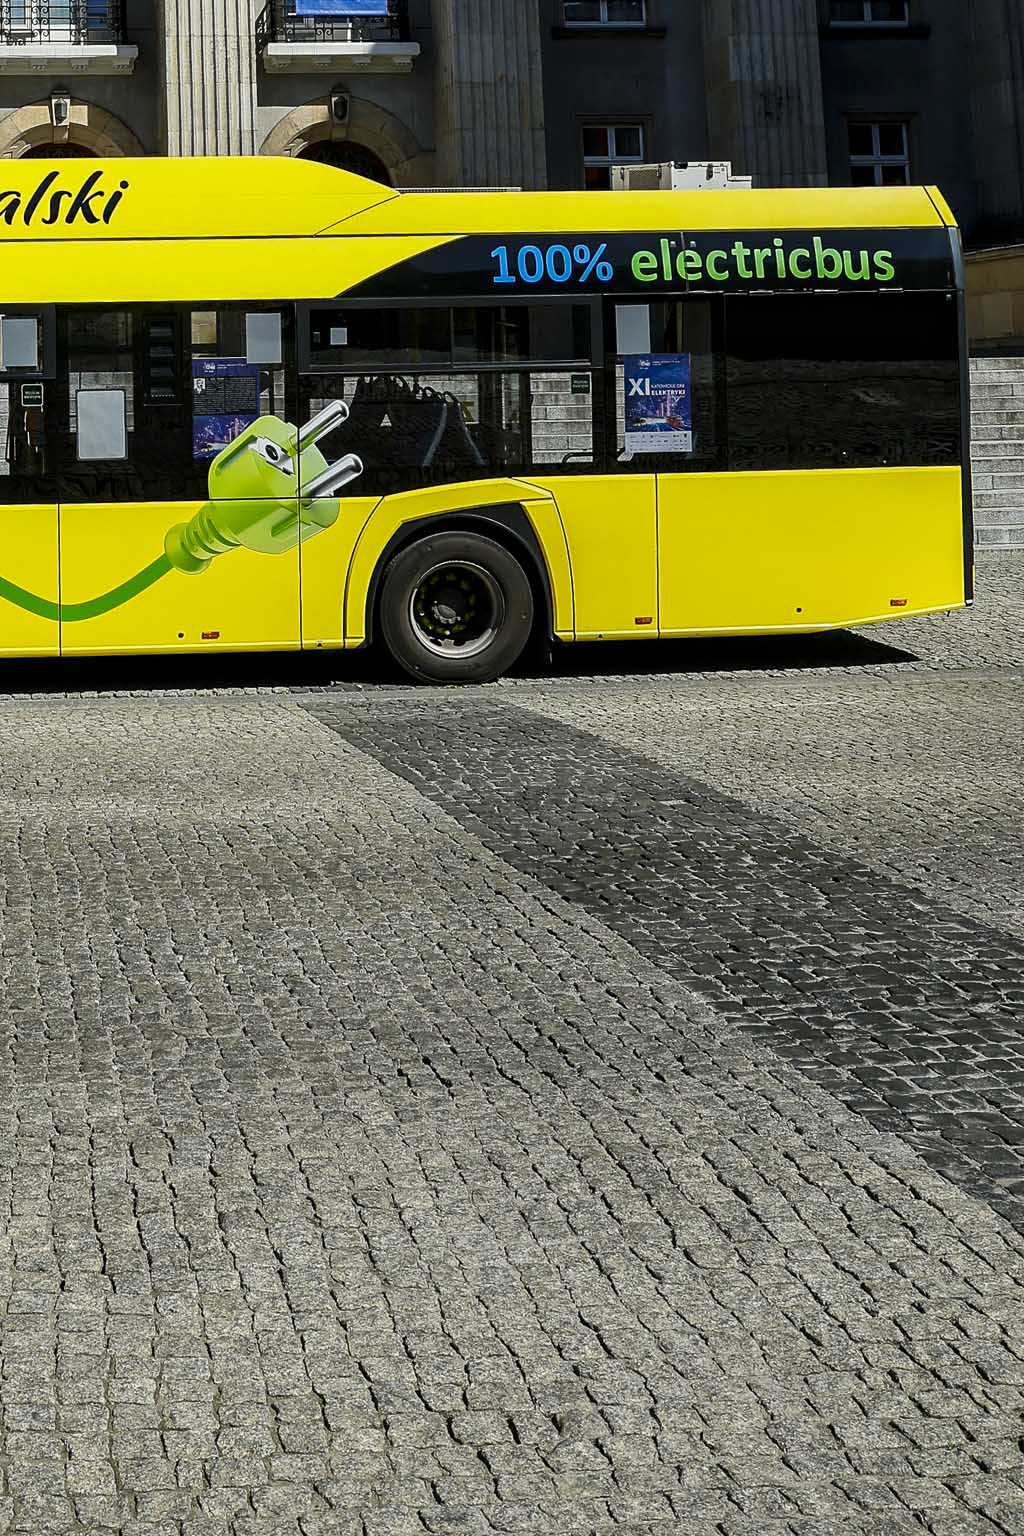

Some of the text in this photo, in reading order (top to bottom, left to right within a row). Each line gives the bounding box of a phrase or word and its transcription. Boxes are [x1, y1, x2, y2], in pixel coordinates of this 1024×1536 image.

[490, 237, 896, 283] 100% electricbus
[628, 377, 651, 396] XI
